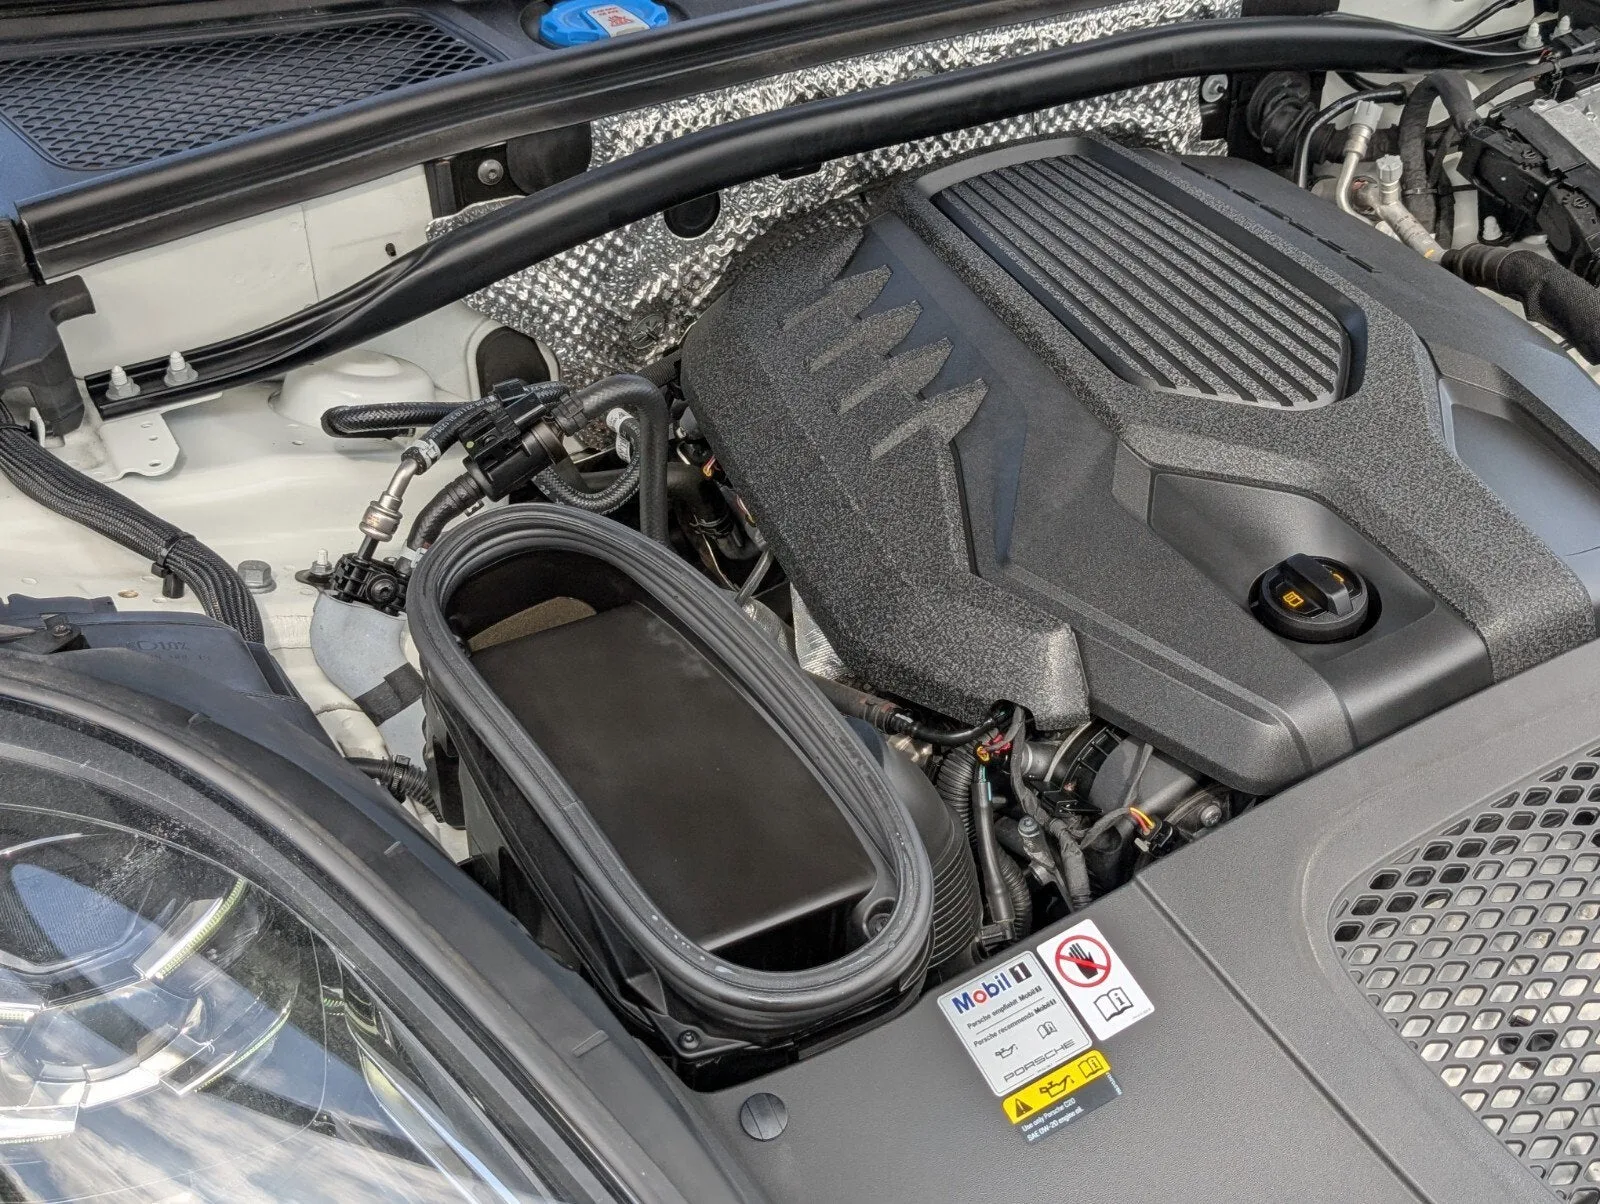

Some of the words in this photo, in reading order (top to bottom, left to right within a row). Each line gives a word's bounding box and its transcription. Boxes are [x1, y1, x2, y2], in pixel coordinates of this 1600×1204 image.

[951, 971, 1012, 1014] Mobil
[967, 1014, 991, 1029] Porsche
[992, 999, 1018, 1016] empfiehlt
[973, 1032, 998, 1047] Porsche
[998, 1012, 1035, 1035] recommends
[1004, 1039, 1076, 1083] PORSCHE
[1021, 1122, 1034, 1132] Use
[1033, 1115, 1045, 1128] only
[1043, 1105, 1064, 1121] Porsche
[1026, 1131, 1040, 1142] SAE
[1039, 1120, 1059, 1136] 0W-20
[1058, 1111, 1076, 1126] engine
